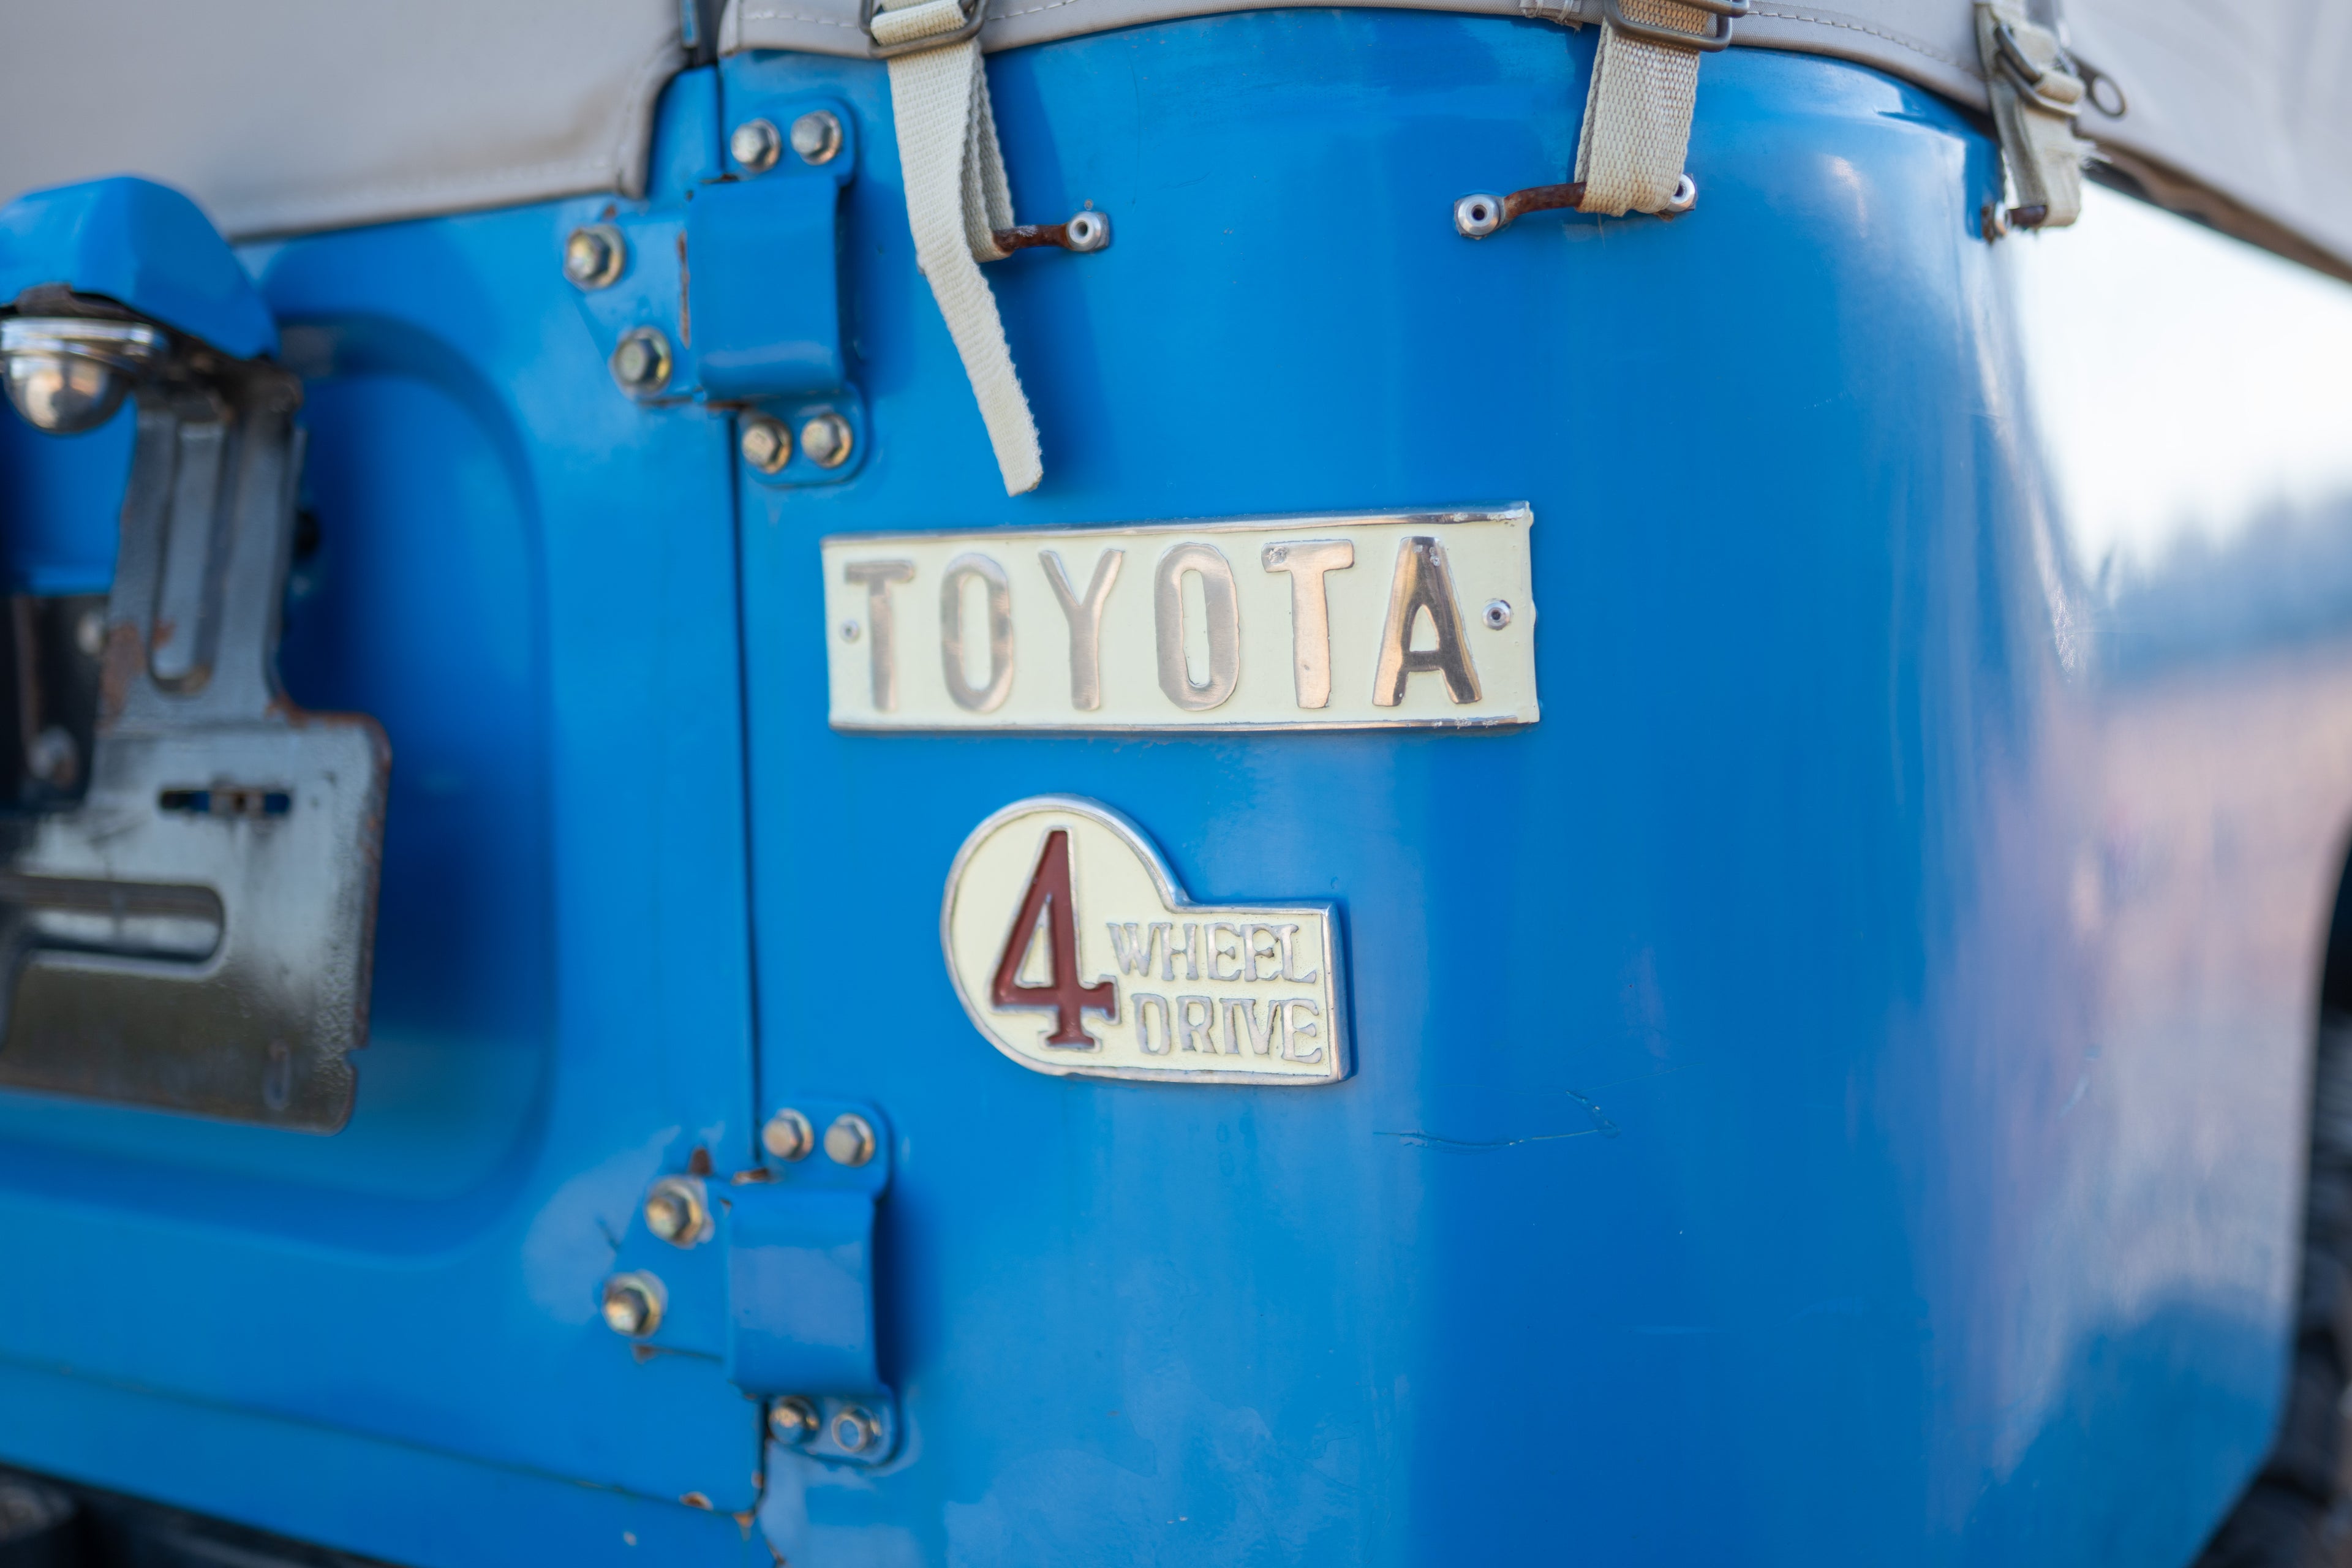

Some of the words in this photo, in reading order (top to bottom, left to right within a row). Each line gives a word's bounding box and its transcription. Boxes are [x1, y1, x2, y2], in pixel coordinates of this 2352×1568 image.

[845, 535, 1482, 712] TOYOTA
[987, 825, 1121, 1053] 4
[1106, 921, 1316, 984] WHEEL
[1130, 992, 1322, 1064] DRIVE
